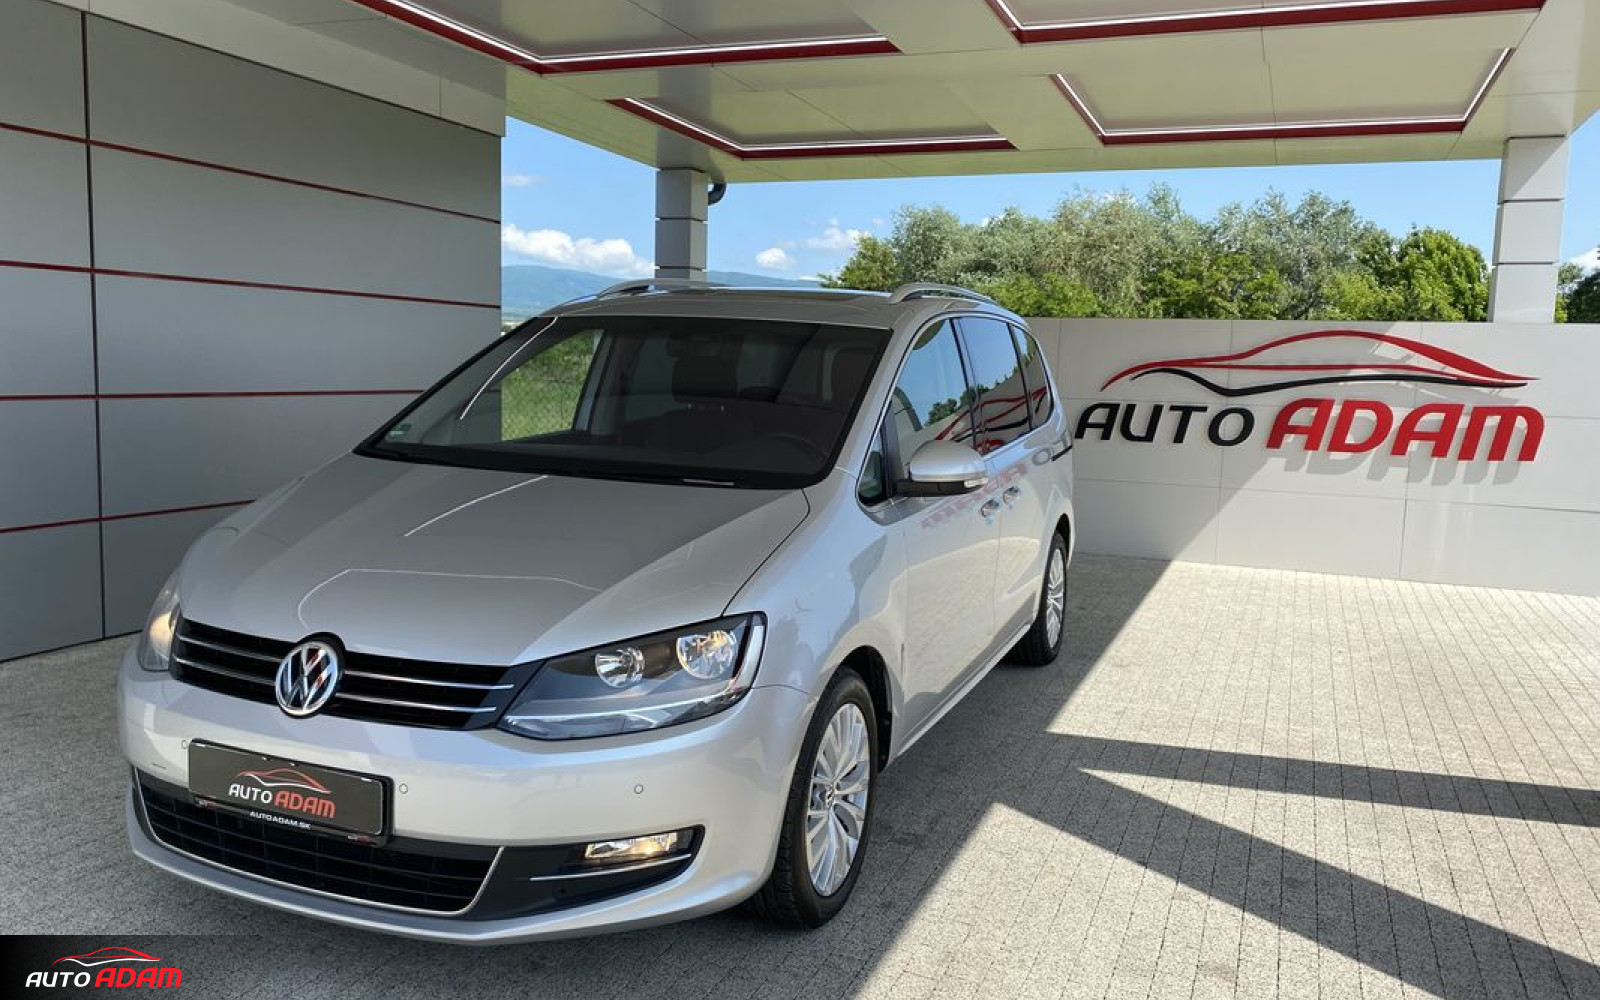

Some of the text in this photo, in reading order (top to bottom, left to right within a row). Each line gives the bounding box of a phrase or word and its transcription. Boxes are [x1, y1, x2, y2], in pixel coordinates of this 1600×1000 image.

[1075, 398, 1545, 461] AUTO ADAM
[228, 784, 273, 804] AUTO
[274, 790, 336, 818] ADAM
